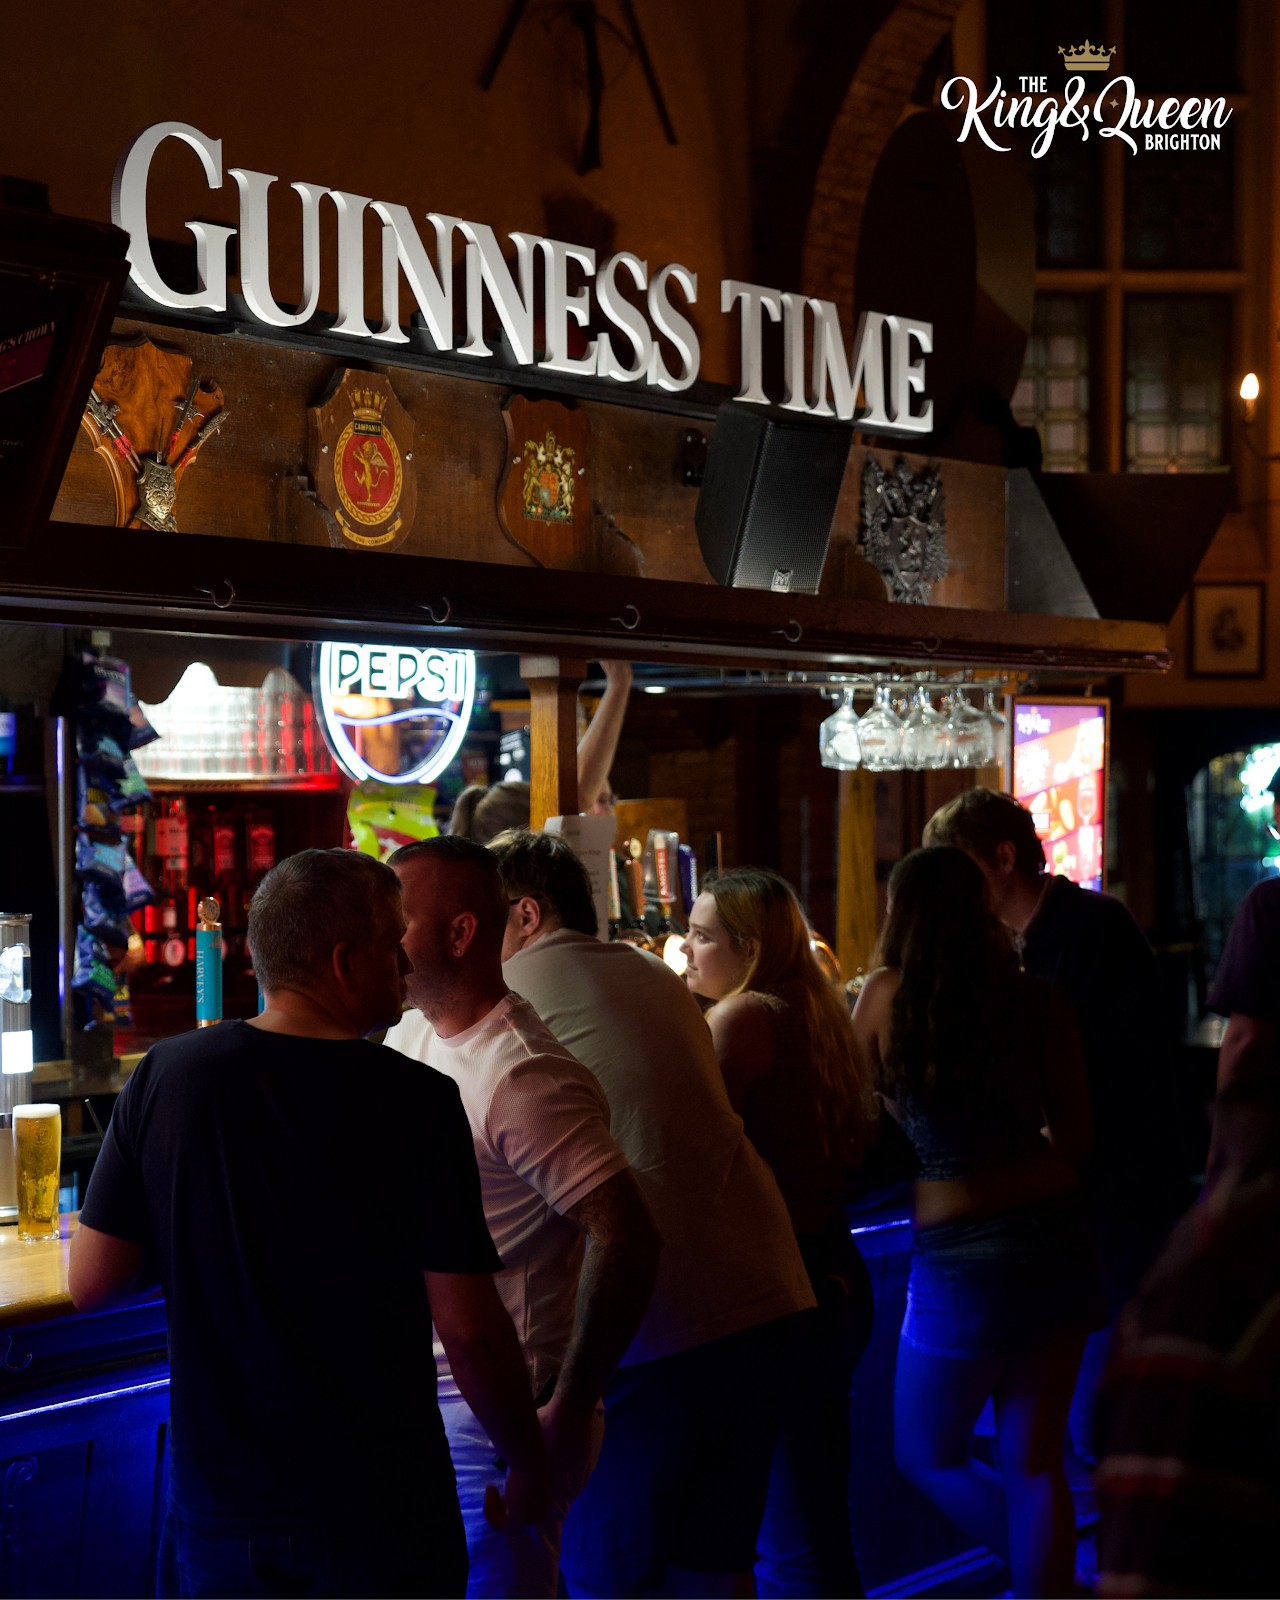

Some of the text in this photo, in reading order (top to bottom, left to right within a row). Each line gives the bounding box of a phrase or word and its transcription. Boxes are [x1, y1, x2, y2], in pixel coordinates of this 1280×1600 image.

[111, 120, 934, 434] GUINNESS TIME
[354, 422, 382, 433] CAMPANIA
[330, 643, 466, 702] PEPSI
